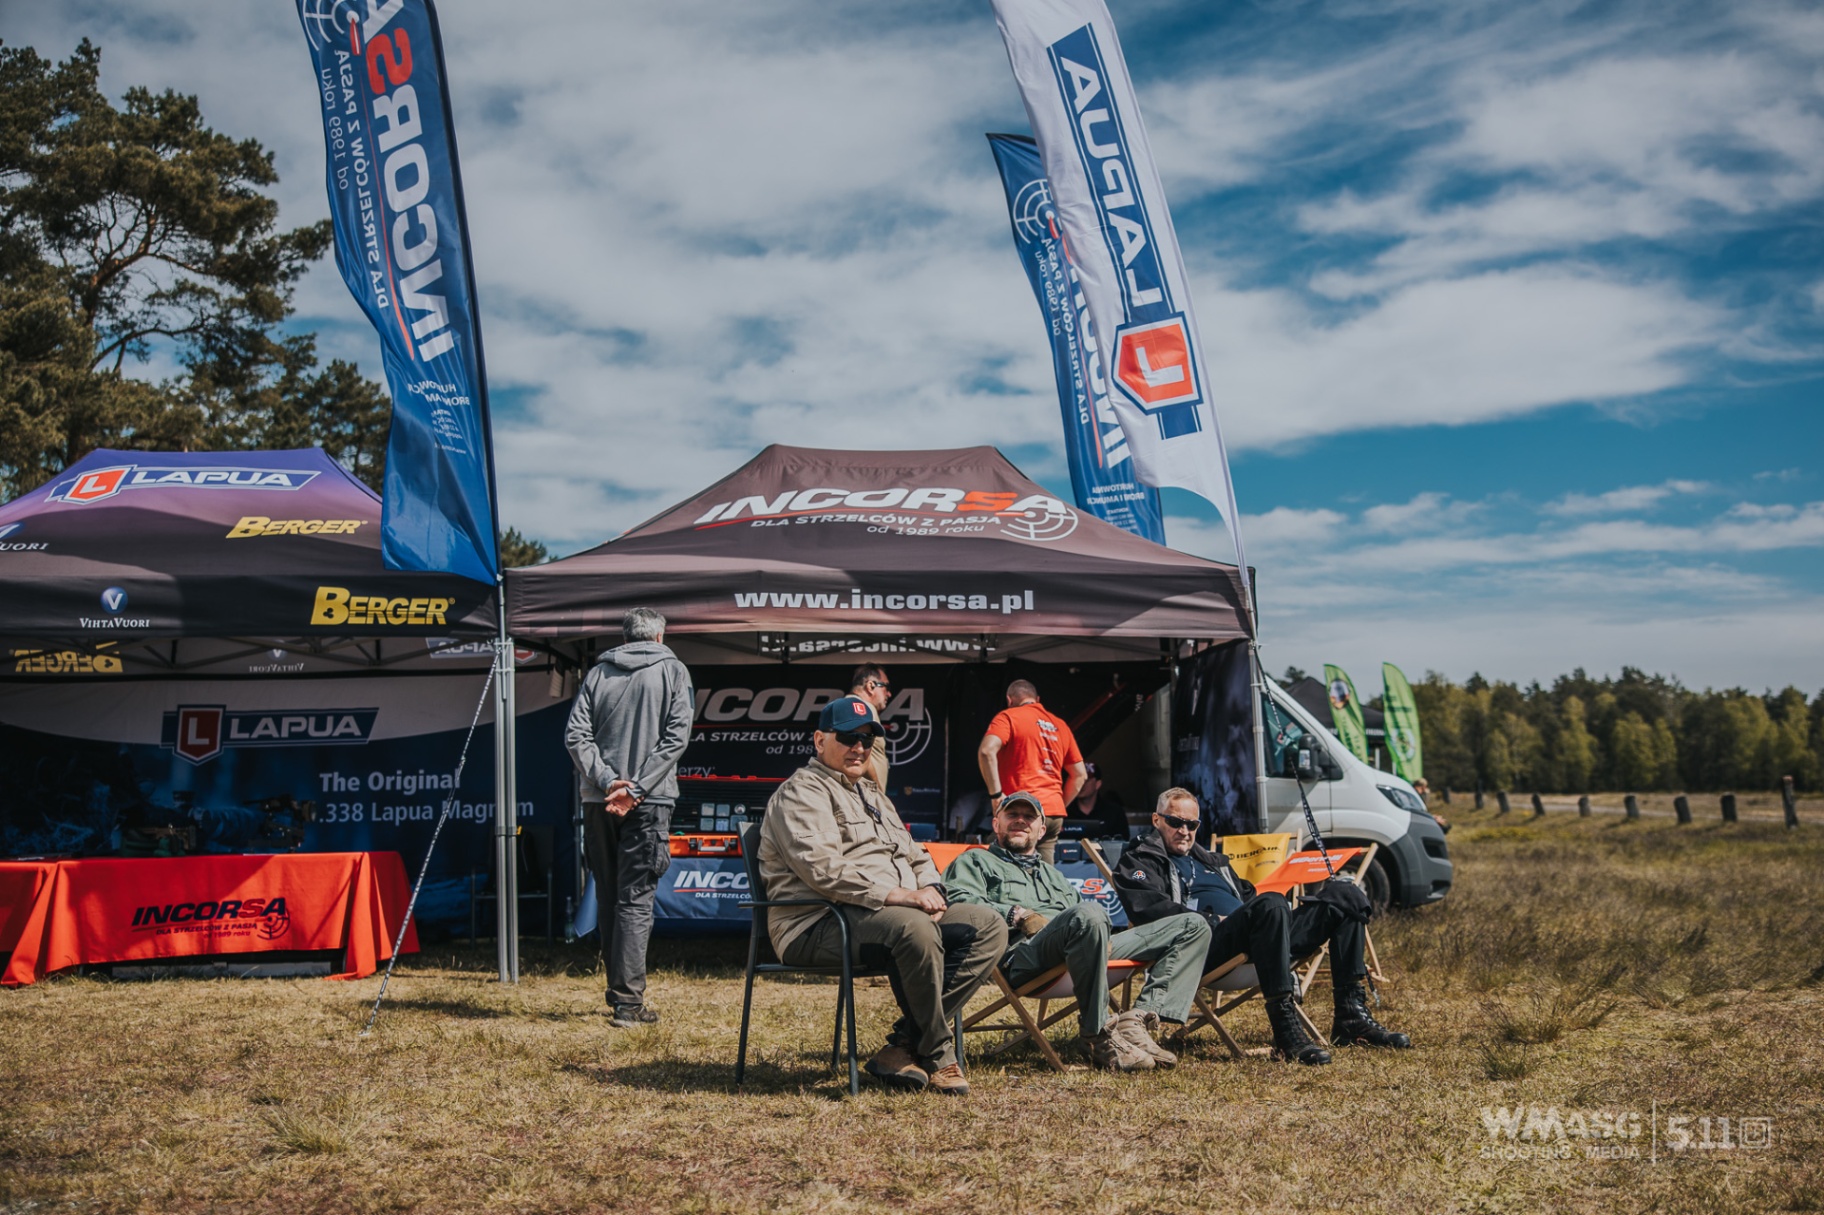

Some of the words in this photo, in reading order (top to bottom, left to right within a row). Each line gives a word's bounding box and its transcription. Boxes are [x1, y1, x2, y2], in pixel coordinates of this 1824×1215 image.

[82, 474, 107, 491] L
[130, 470, 294, 488] LAPUA
[694, 487, 1067, 525] INCORSA
[226, 516, 357, 539] BERGER
[751, 519, 789, 528] DLA
[794, 512, 915, 526] STRZELCÓW
[921, 518, 933, 526] Z
[867, 524, 889, 534] od
[895, 526, 939, 536] 1989
[945, 524, 985, 534] roku
[0, 541, 49, 551] UORI
[310, 586, 448, 625] BERGER
[734, 588, 1035, 614] www.incorsa.pl
[187, 717, 210, 746] L
[229, 715, 362, 740] LAPUA
[710, 729, 805, 742] STRZELCÓW
[766, 744, 783, 755] od
[788, 745, 818, 755] 198
[319, 772, 361, 793] The
[367, 769, 461, 795] Original
[318, 803, 363, 823] .338
[371, 801, 434, 827] Lapua
[442, 800, 534, 824] Magnm
[712, 892, 752, 900] STRZELCÓ
[131, 897, 286, 927] INCORSA
